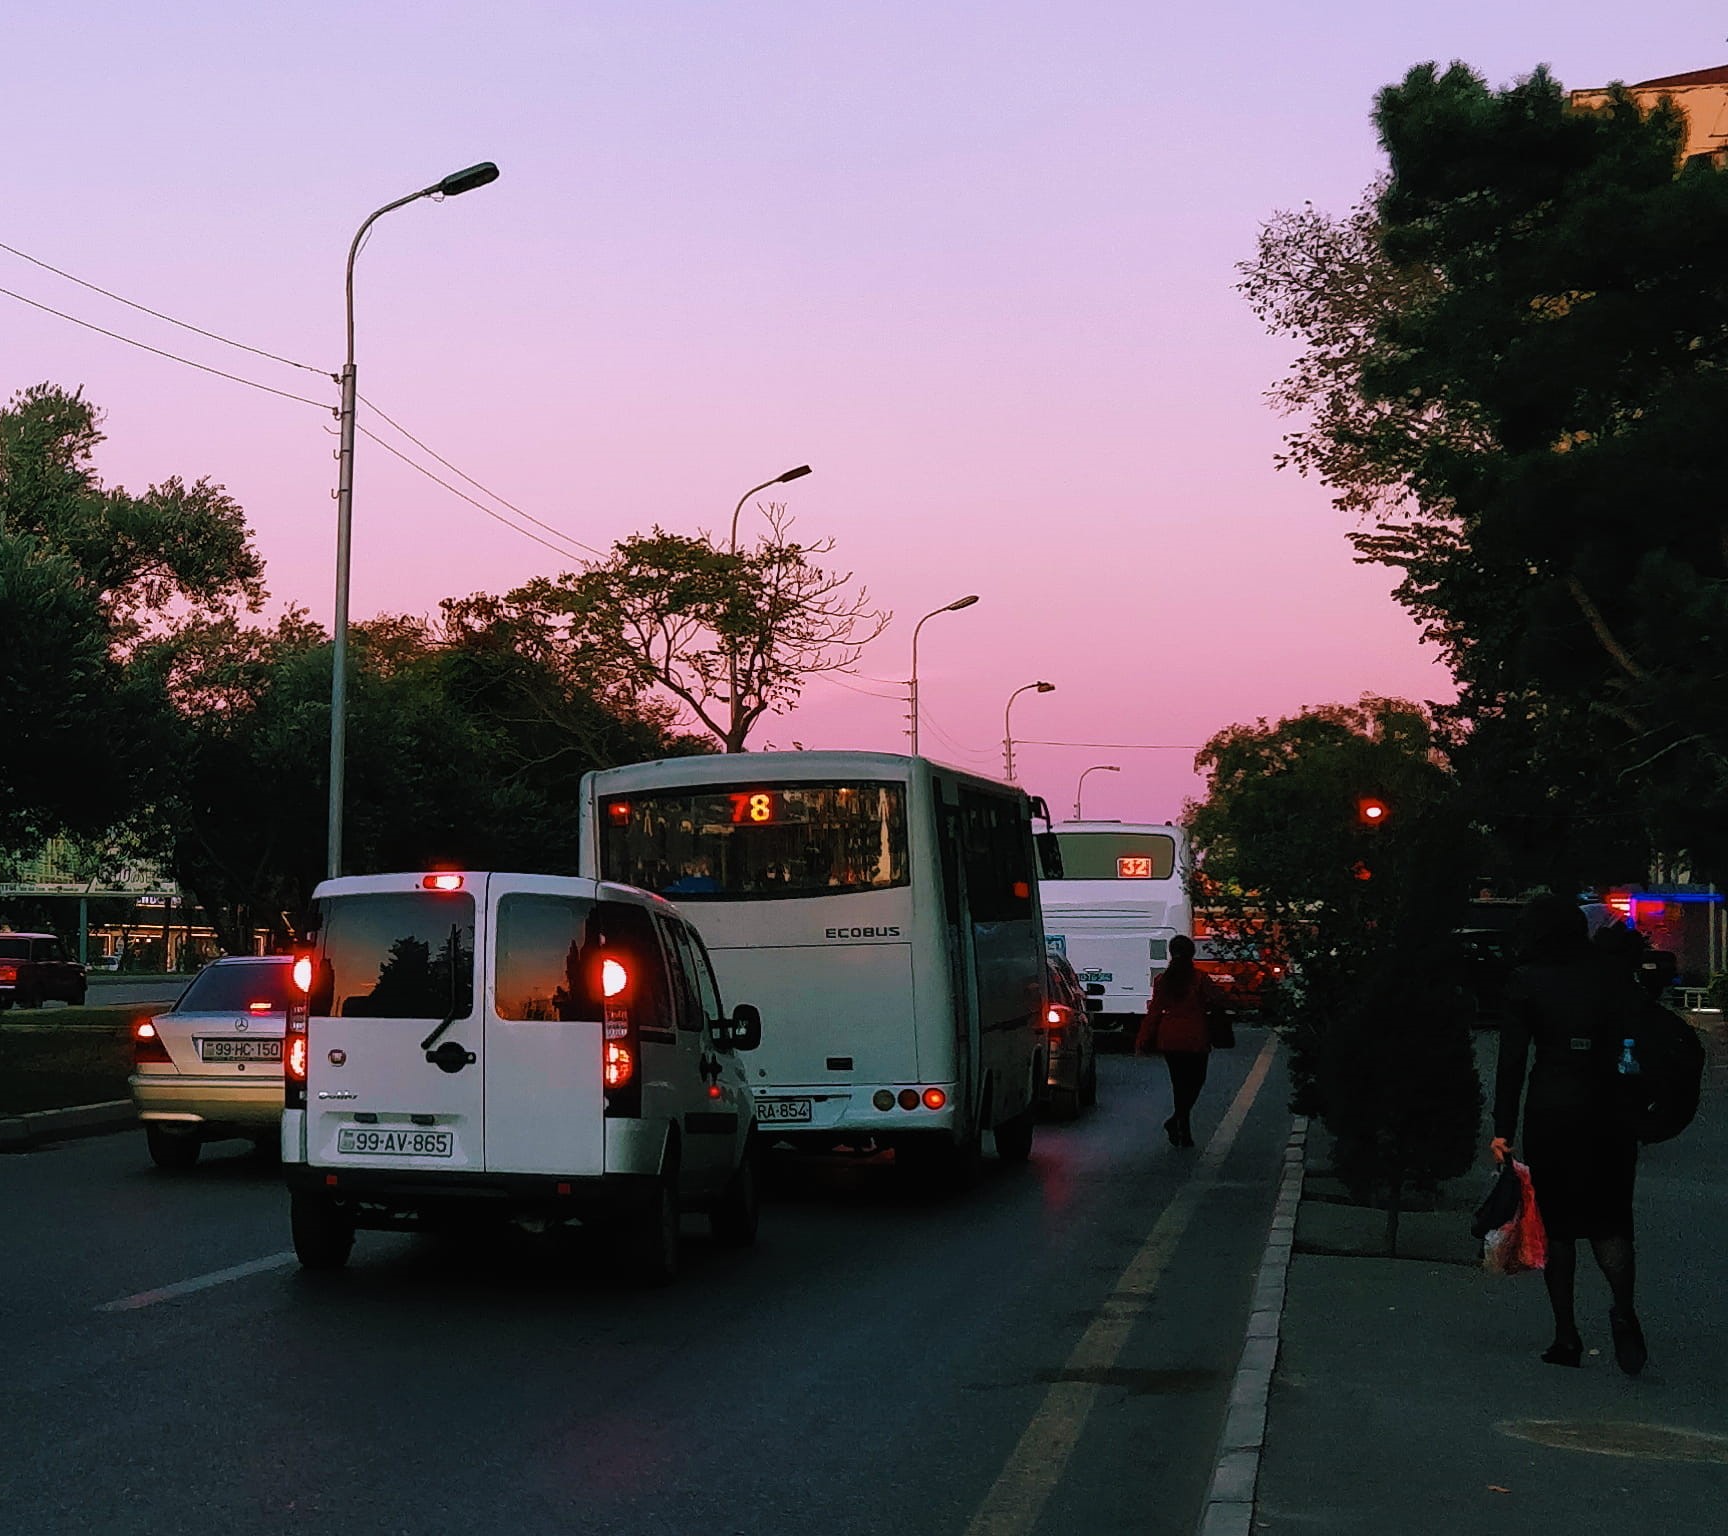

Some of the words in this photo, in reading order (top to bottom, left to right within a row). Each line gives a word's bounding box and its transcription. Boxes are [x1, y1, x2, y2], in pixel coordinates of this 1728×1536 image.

[729, 793, 770, 822] 78
[1122, 859, 1148, 875] 32
[825, 926, 901, 939] ECOBUS
[215, 1043, 279, 1056] 99-HC-150
[356, 1133, 447, 1153] 99-AV-865
